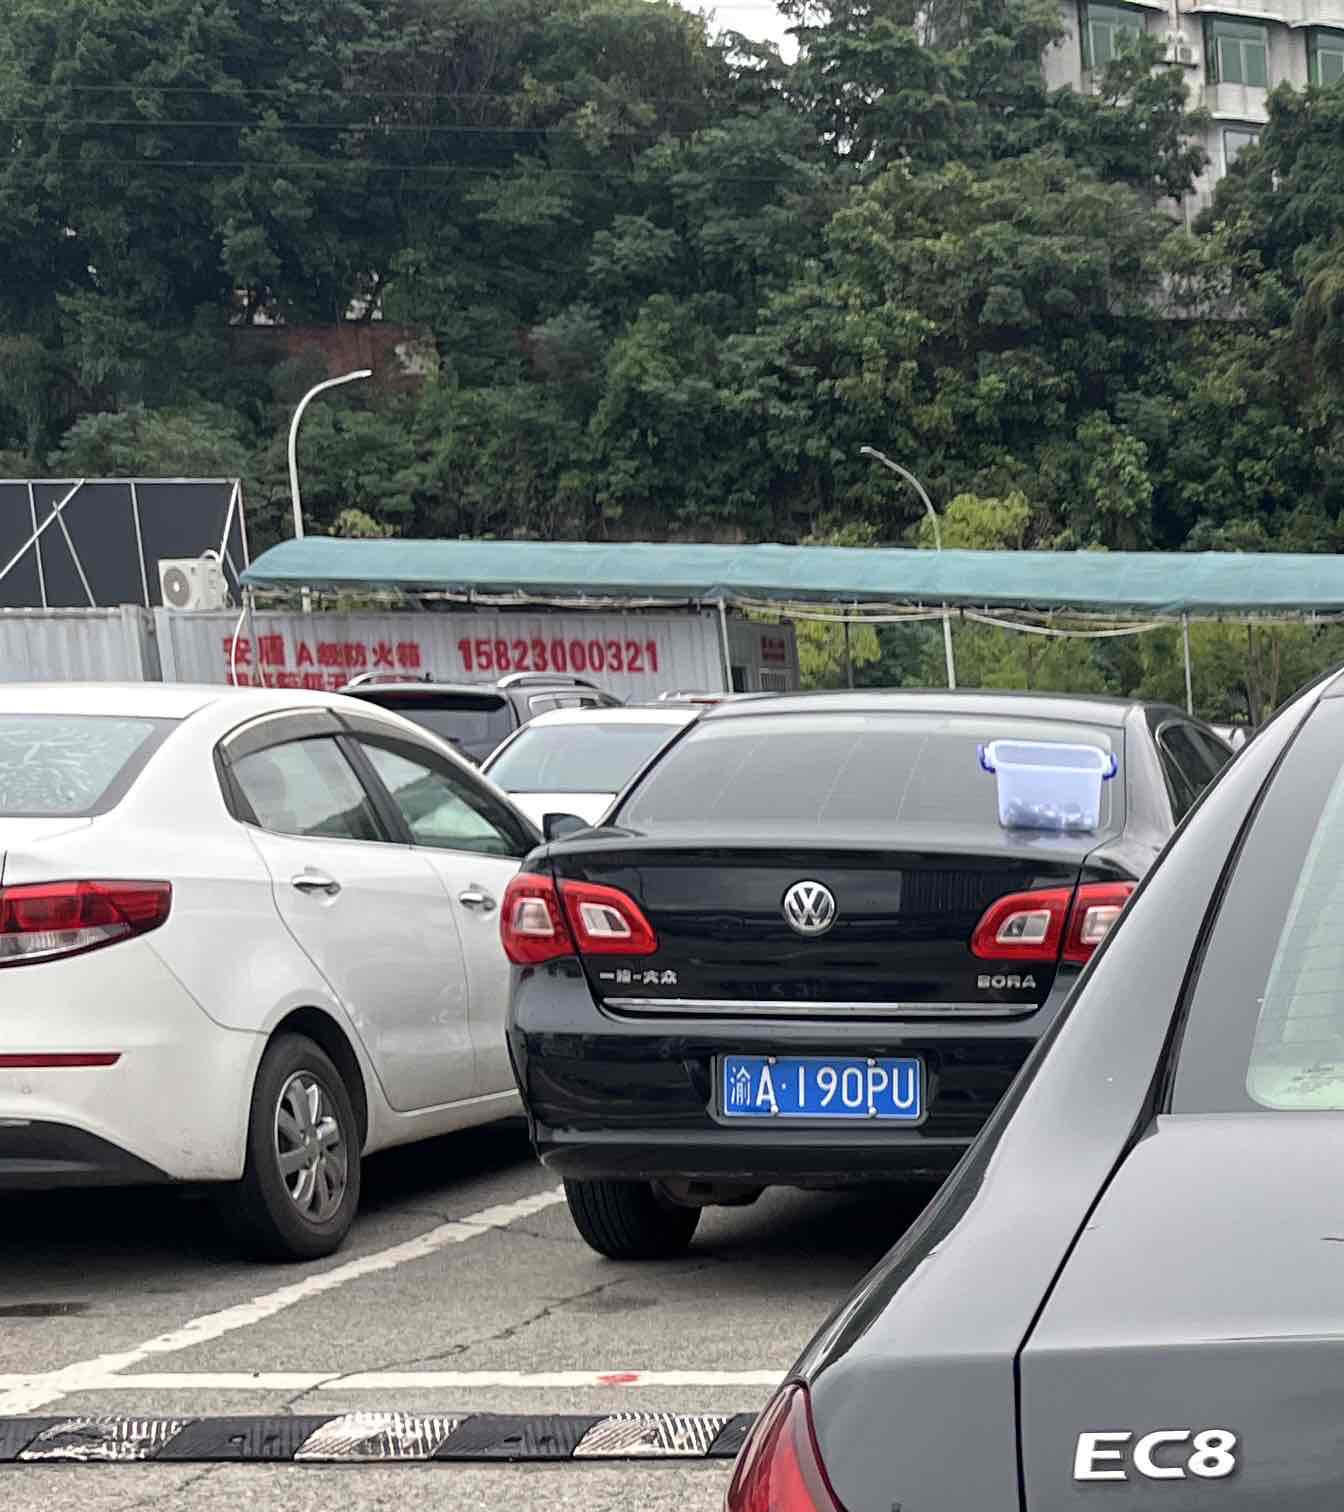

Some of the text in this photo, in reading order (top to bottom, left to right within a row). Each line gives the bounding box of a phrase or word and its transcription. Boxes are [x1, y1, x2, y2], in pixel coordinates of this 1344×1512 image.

[458, 638, 659, 673] 15823000321
[977, 974, 1037, 989] BORA
[1072, 1428, 1238, 1482] EC8
